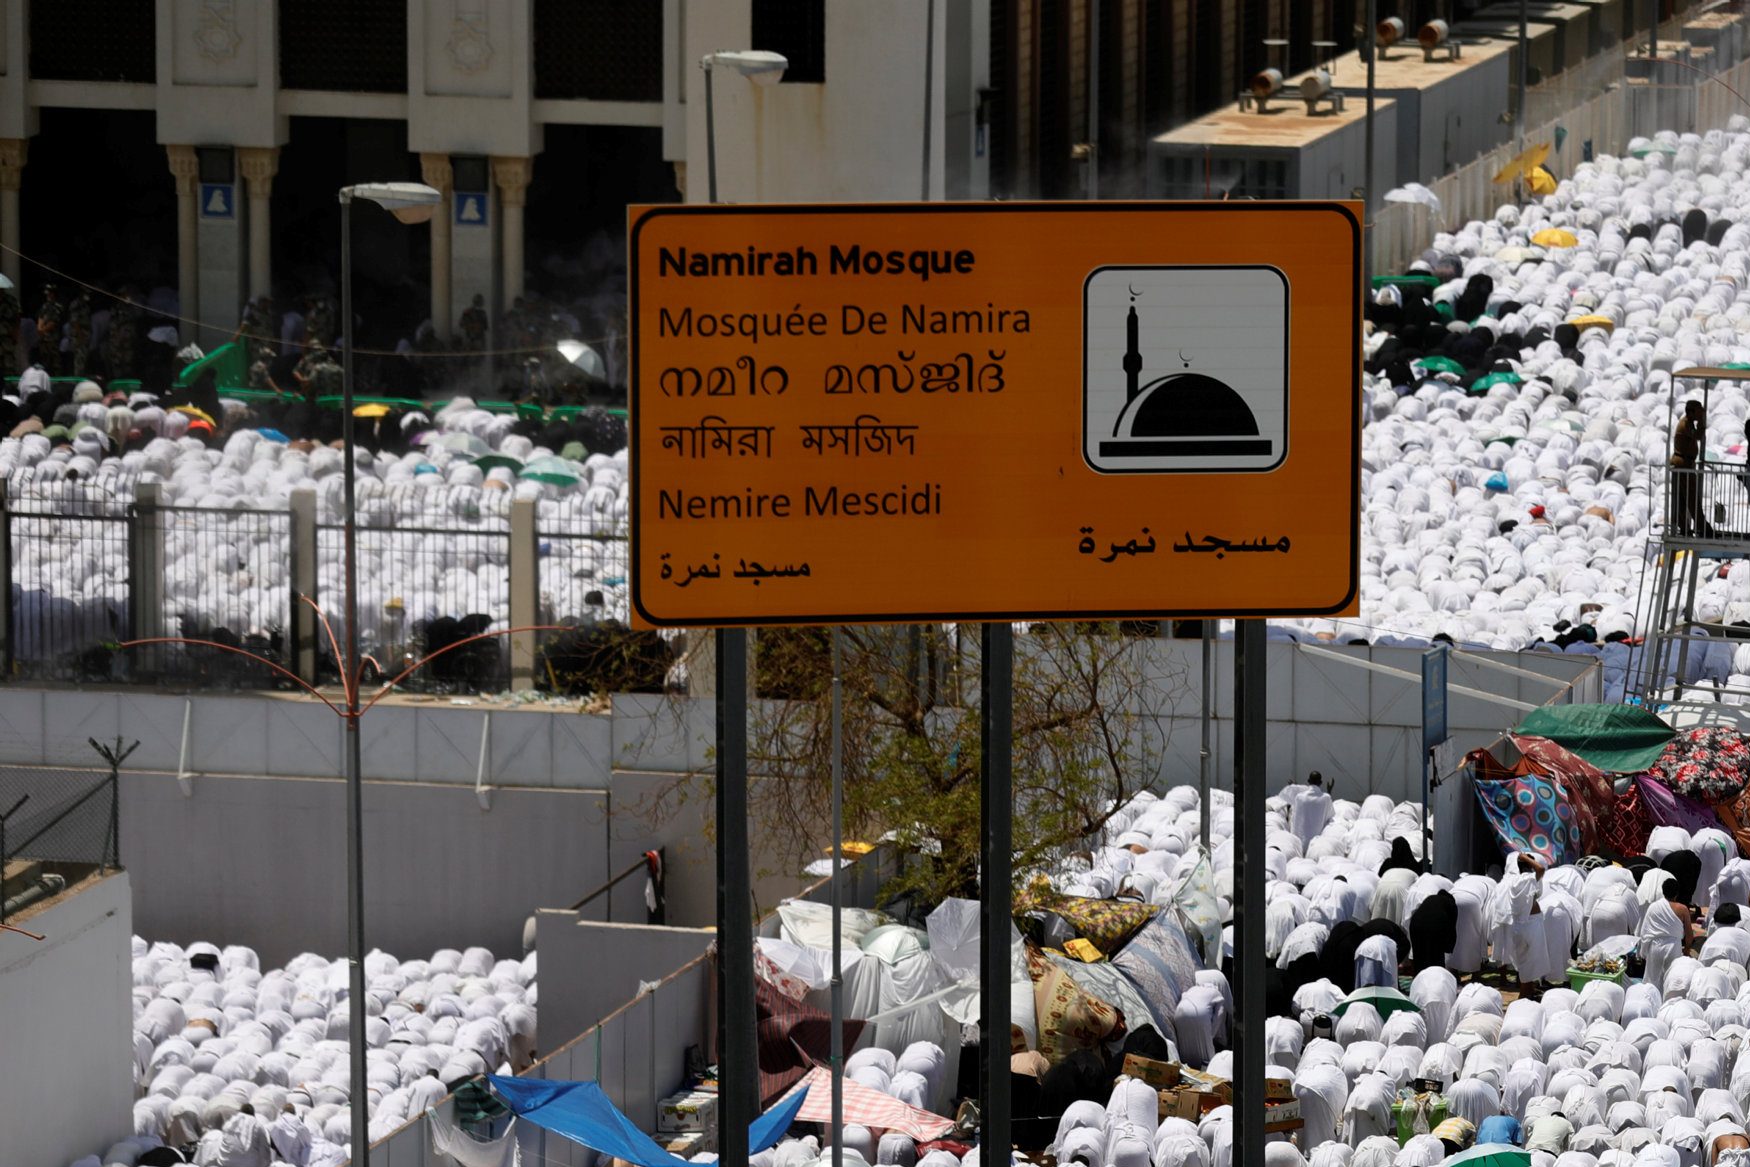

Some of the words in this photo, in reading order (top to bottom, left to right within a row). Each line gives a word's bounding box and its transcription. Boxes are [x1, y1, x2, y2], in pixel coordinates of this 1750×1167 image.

[660, 246, 817, 277] Namirah
[830, 245, 975, 281] Mosque
[660, 304, 828, 344] Mosquée
[842, 304, 888, 335] De
[902, 303, 1030, 335] Namira
[660, 416, 775, 458] নামিরা
[799, 415, 919, 456] মসজিদ
[660, 488, 790, 518] Nemire
[806, 484, 941, 516] Mescidi
[1079, 527, 1156, 564] نمرة
[1173, 530, 1291, 560] مسجد
[661, 553, 720, 588] نمرة
[733, 559, 811, 587] مسجد
